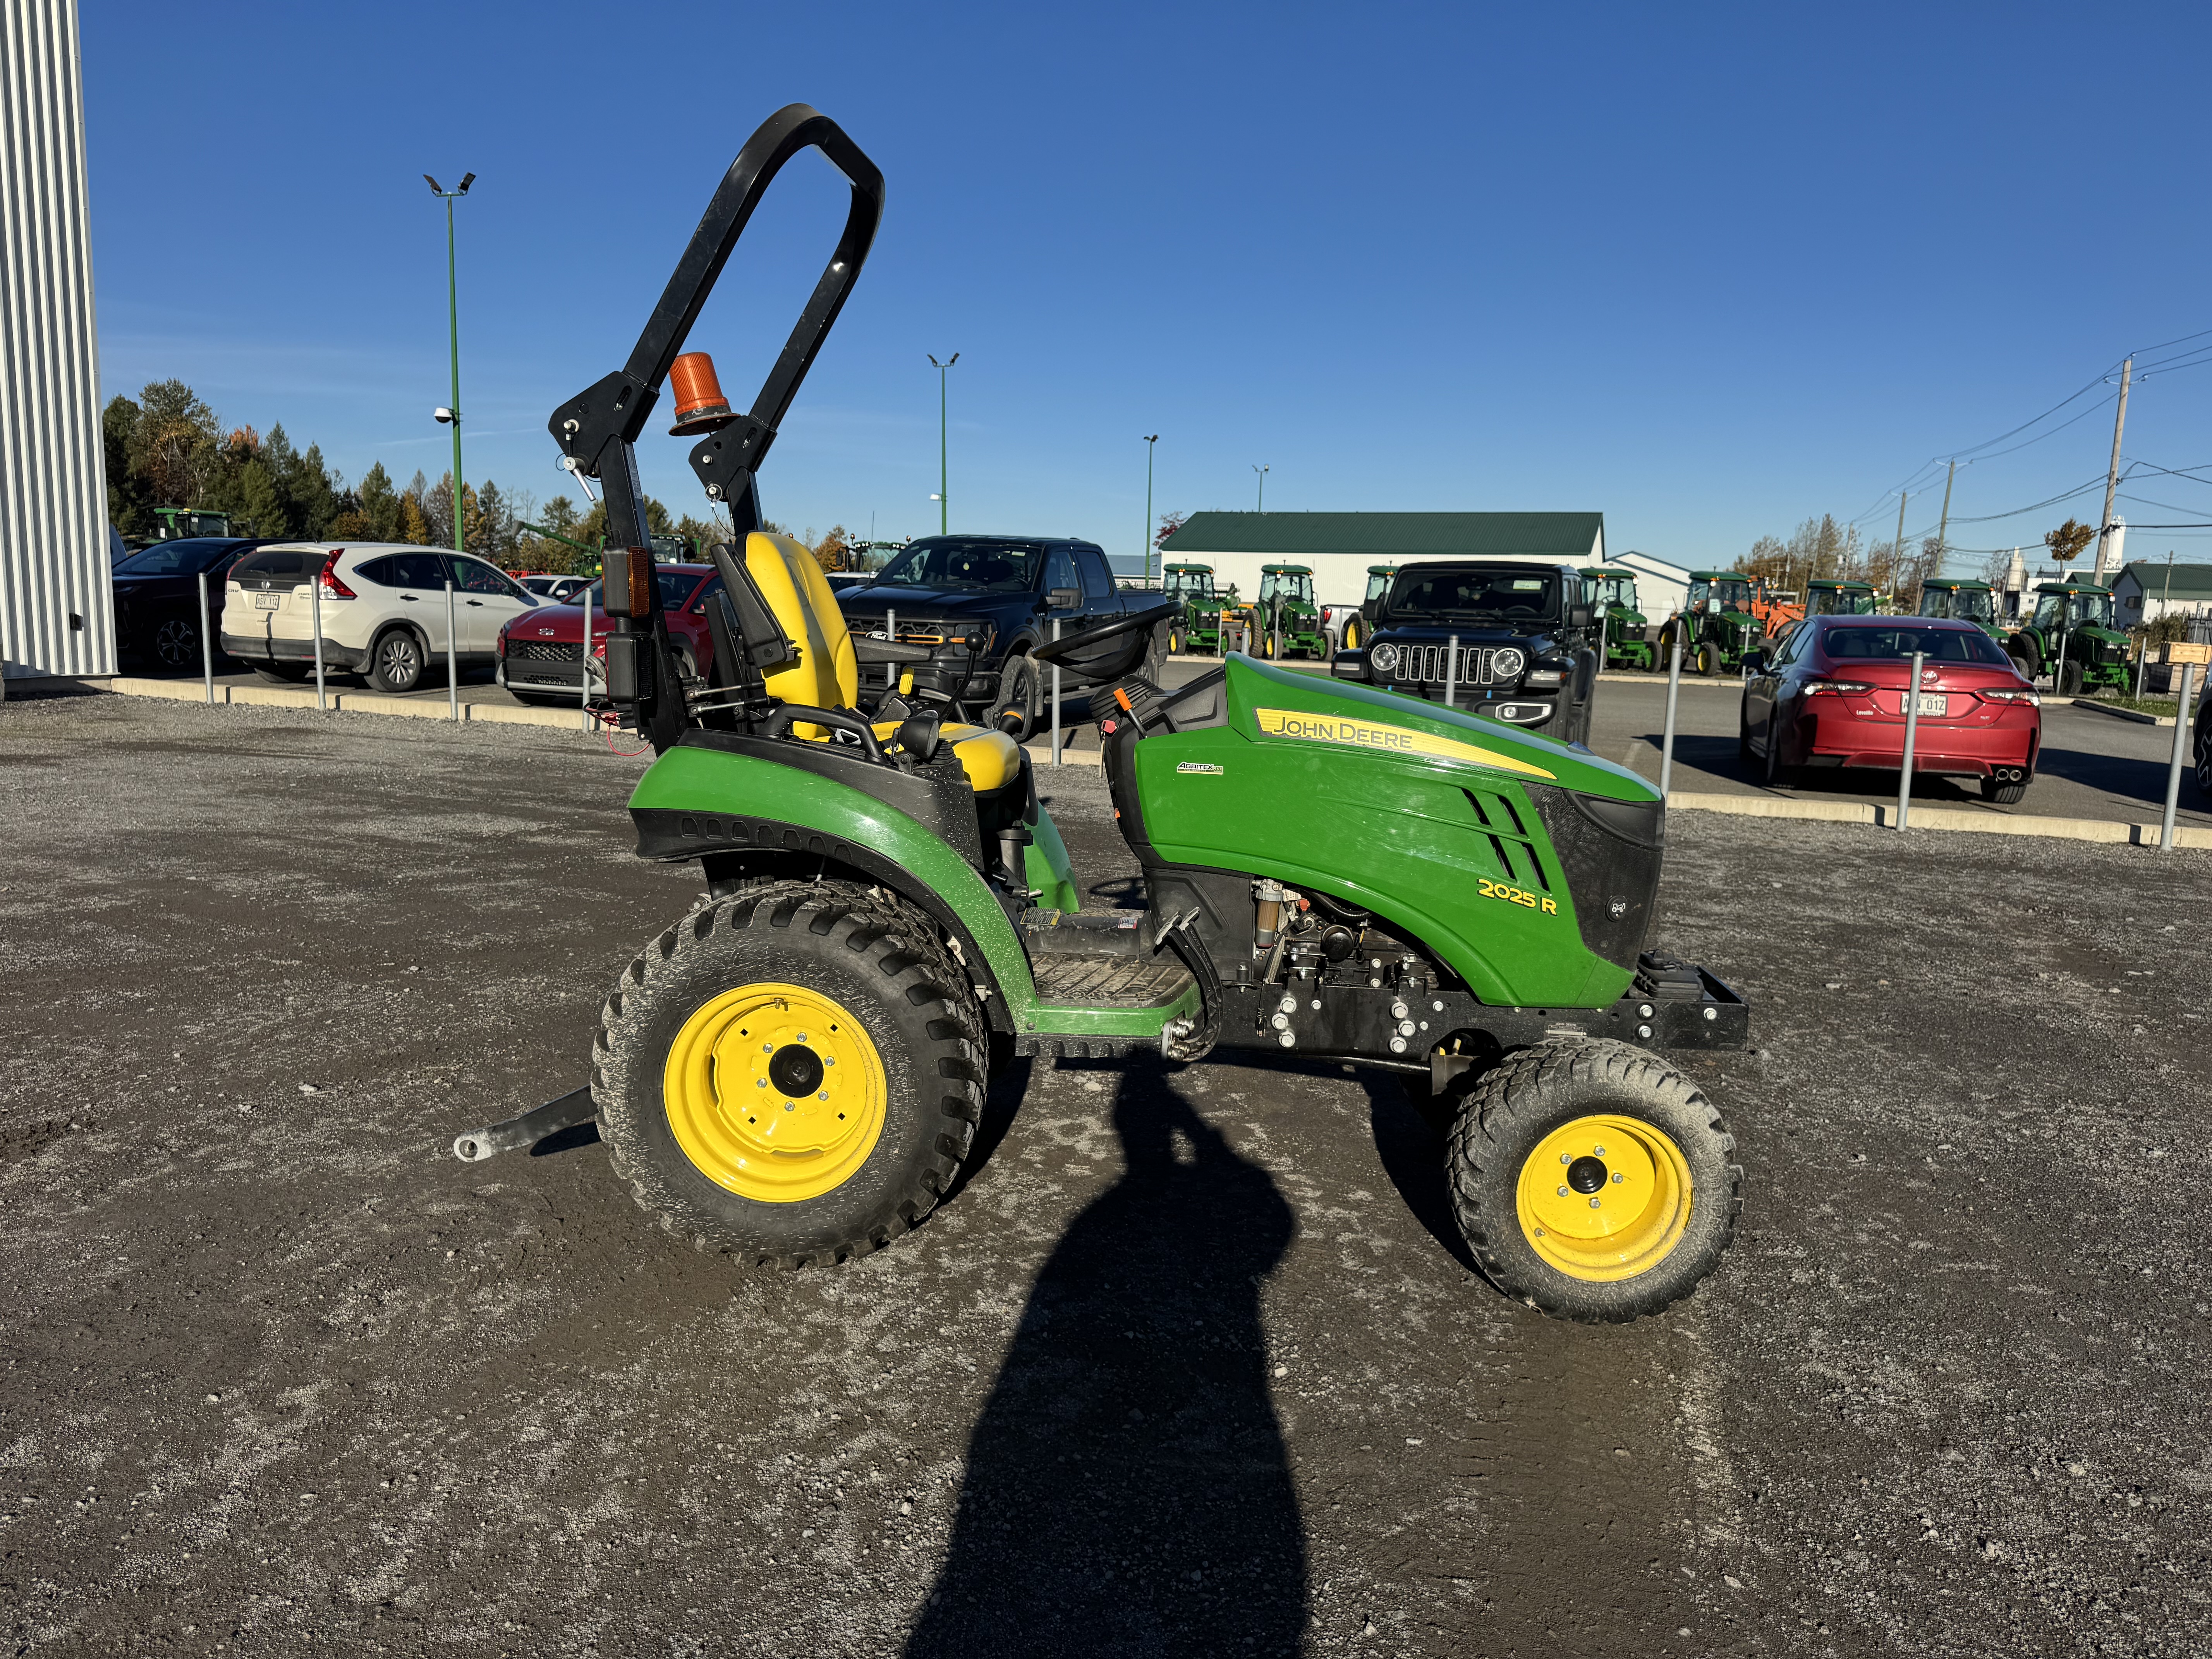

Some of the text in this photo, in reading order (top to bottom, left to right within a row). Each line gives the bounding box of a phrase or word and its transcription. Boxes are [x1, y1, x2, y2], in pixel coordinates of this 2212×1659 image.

[257, 597, 266, 605] ASV
[1274, 717, 1413, 749] JOHN DEERE
[1477, 878, 1557, 916] 2025 R
